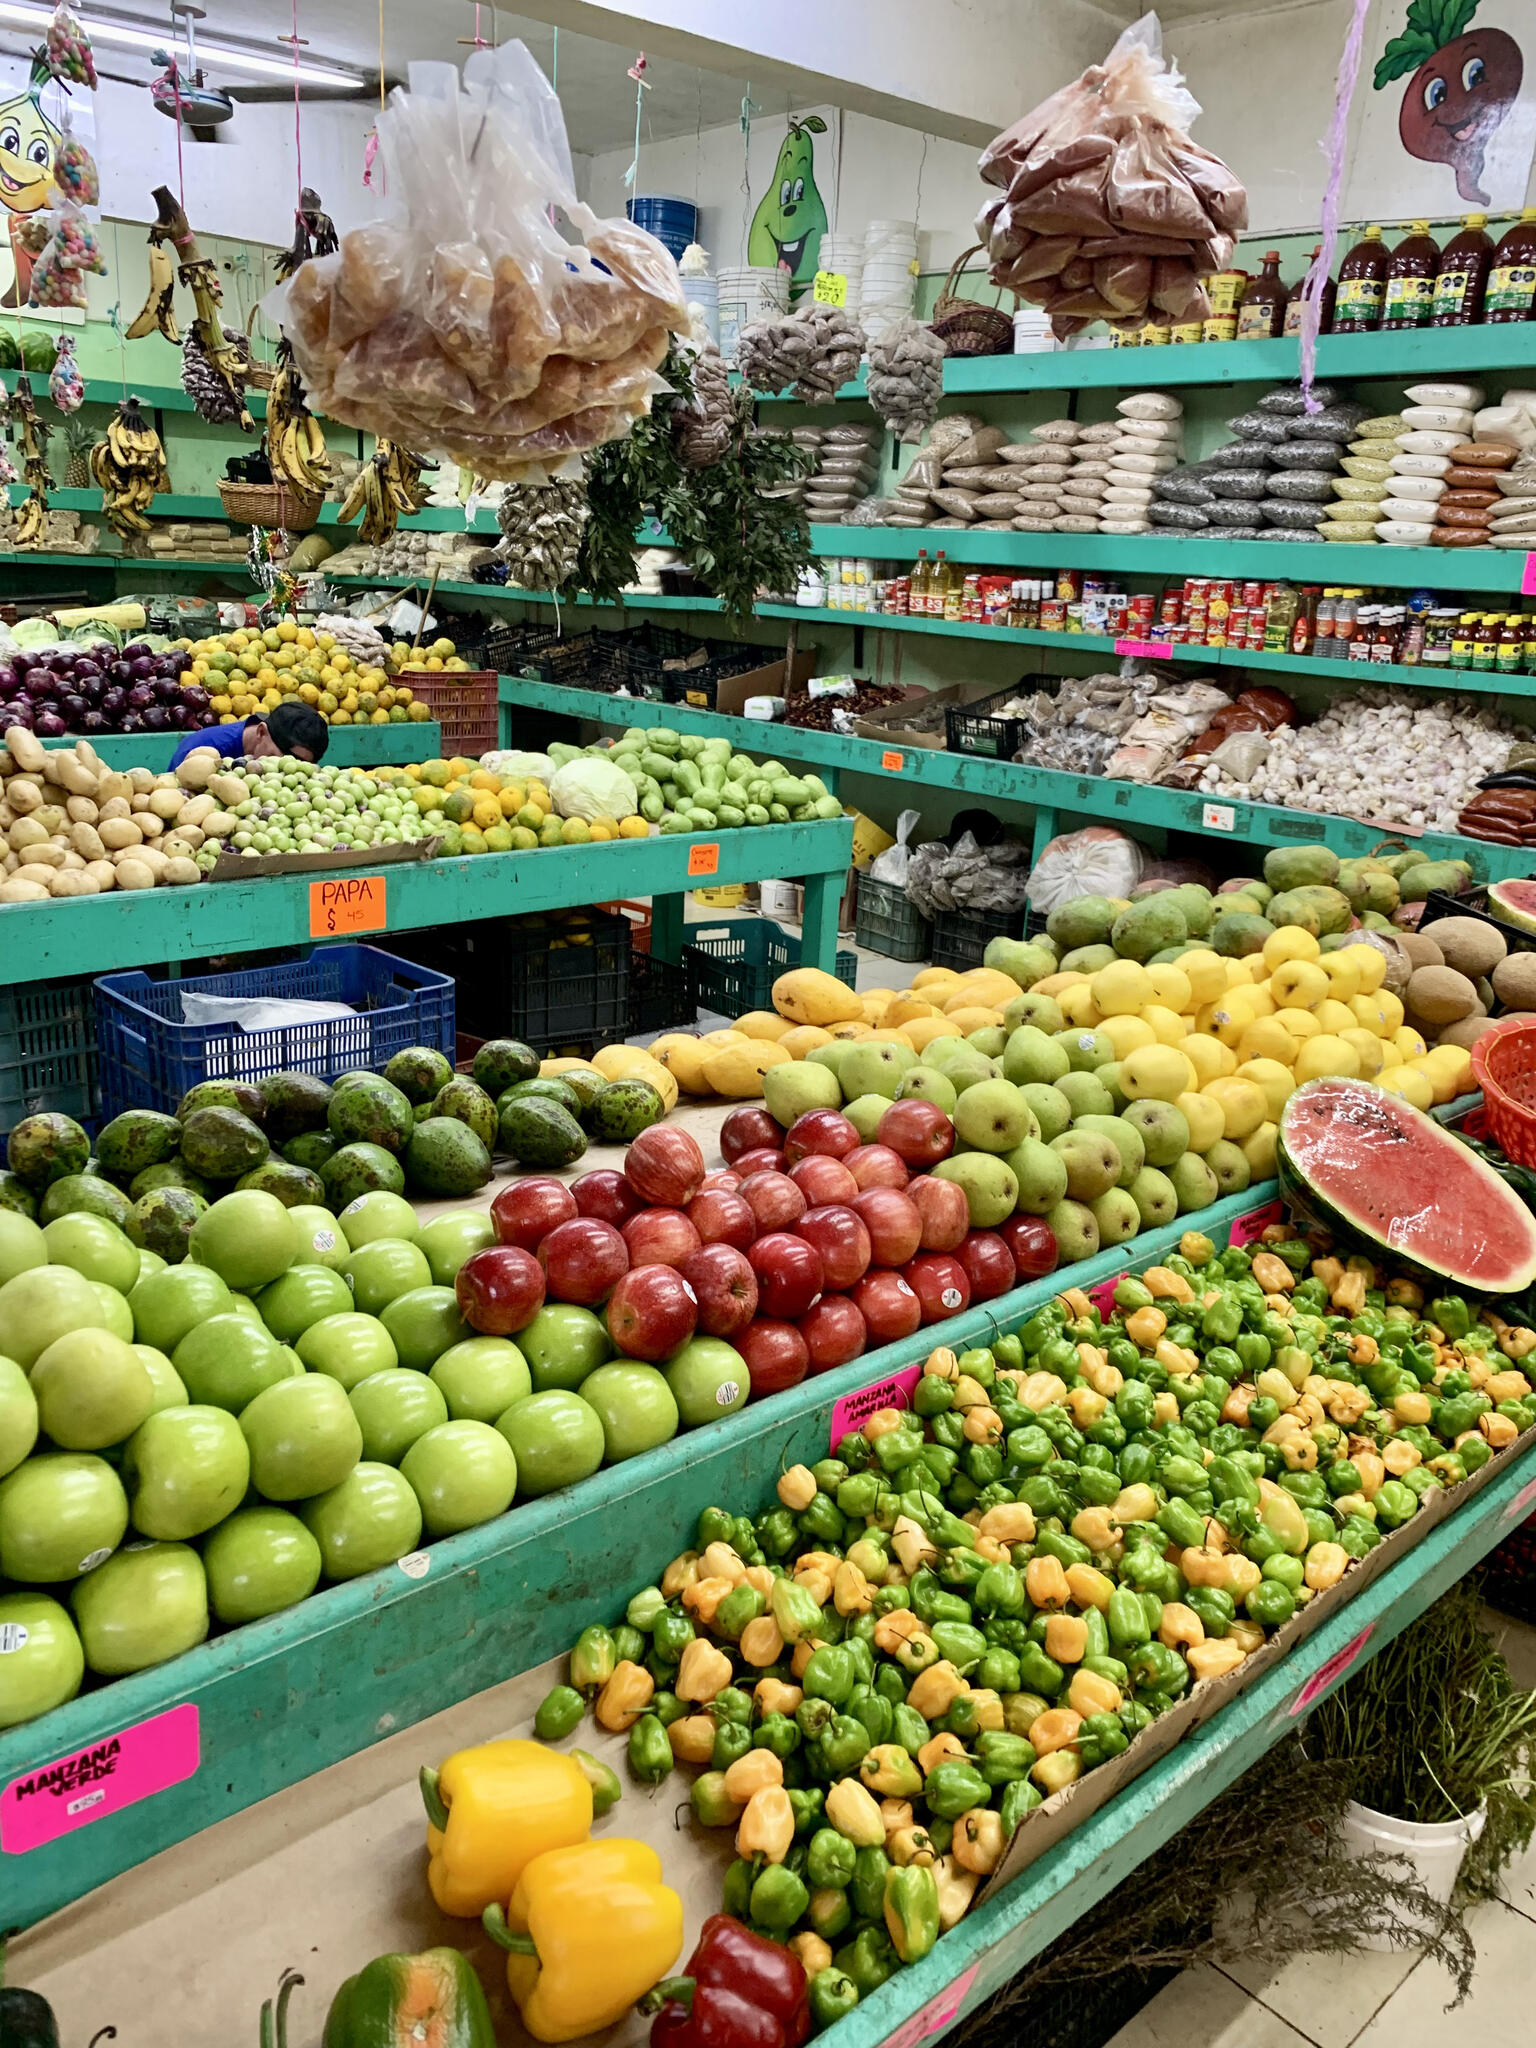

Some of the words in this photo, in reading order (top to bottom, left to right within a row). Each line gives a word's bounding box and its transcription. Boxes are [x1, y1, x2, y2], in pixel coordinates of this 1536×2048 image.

[322, 879, 373, 905] PAPA
[327, 908, 336, 930] $
[346, 909, 364, 922] 45
[843, 1382, 897, 1414] MANZANA
[16, 1739, 121, 1801] MANZANA
[49, 1757, 118, 1797] VERDE
